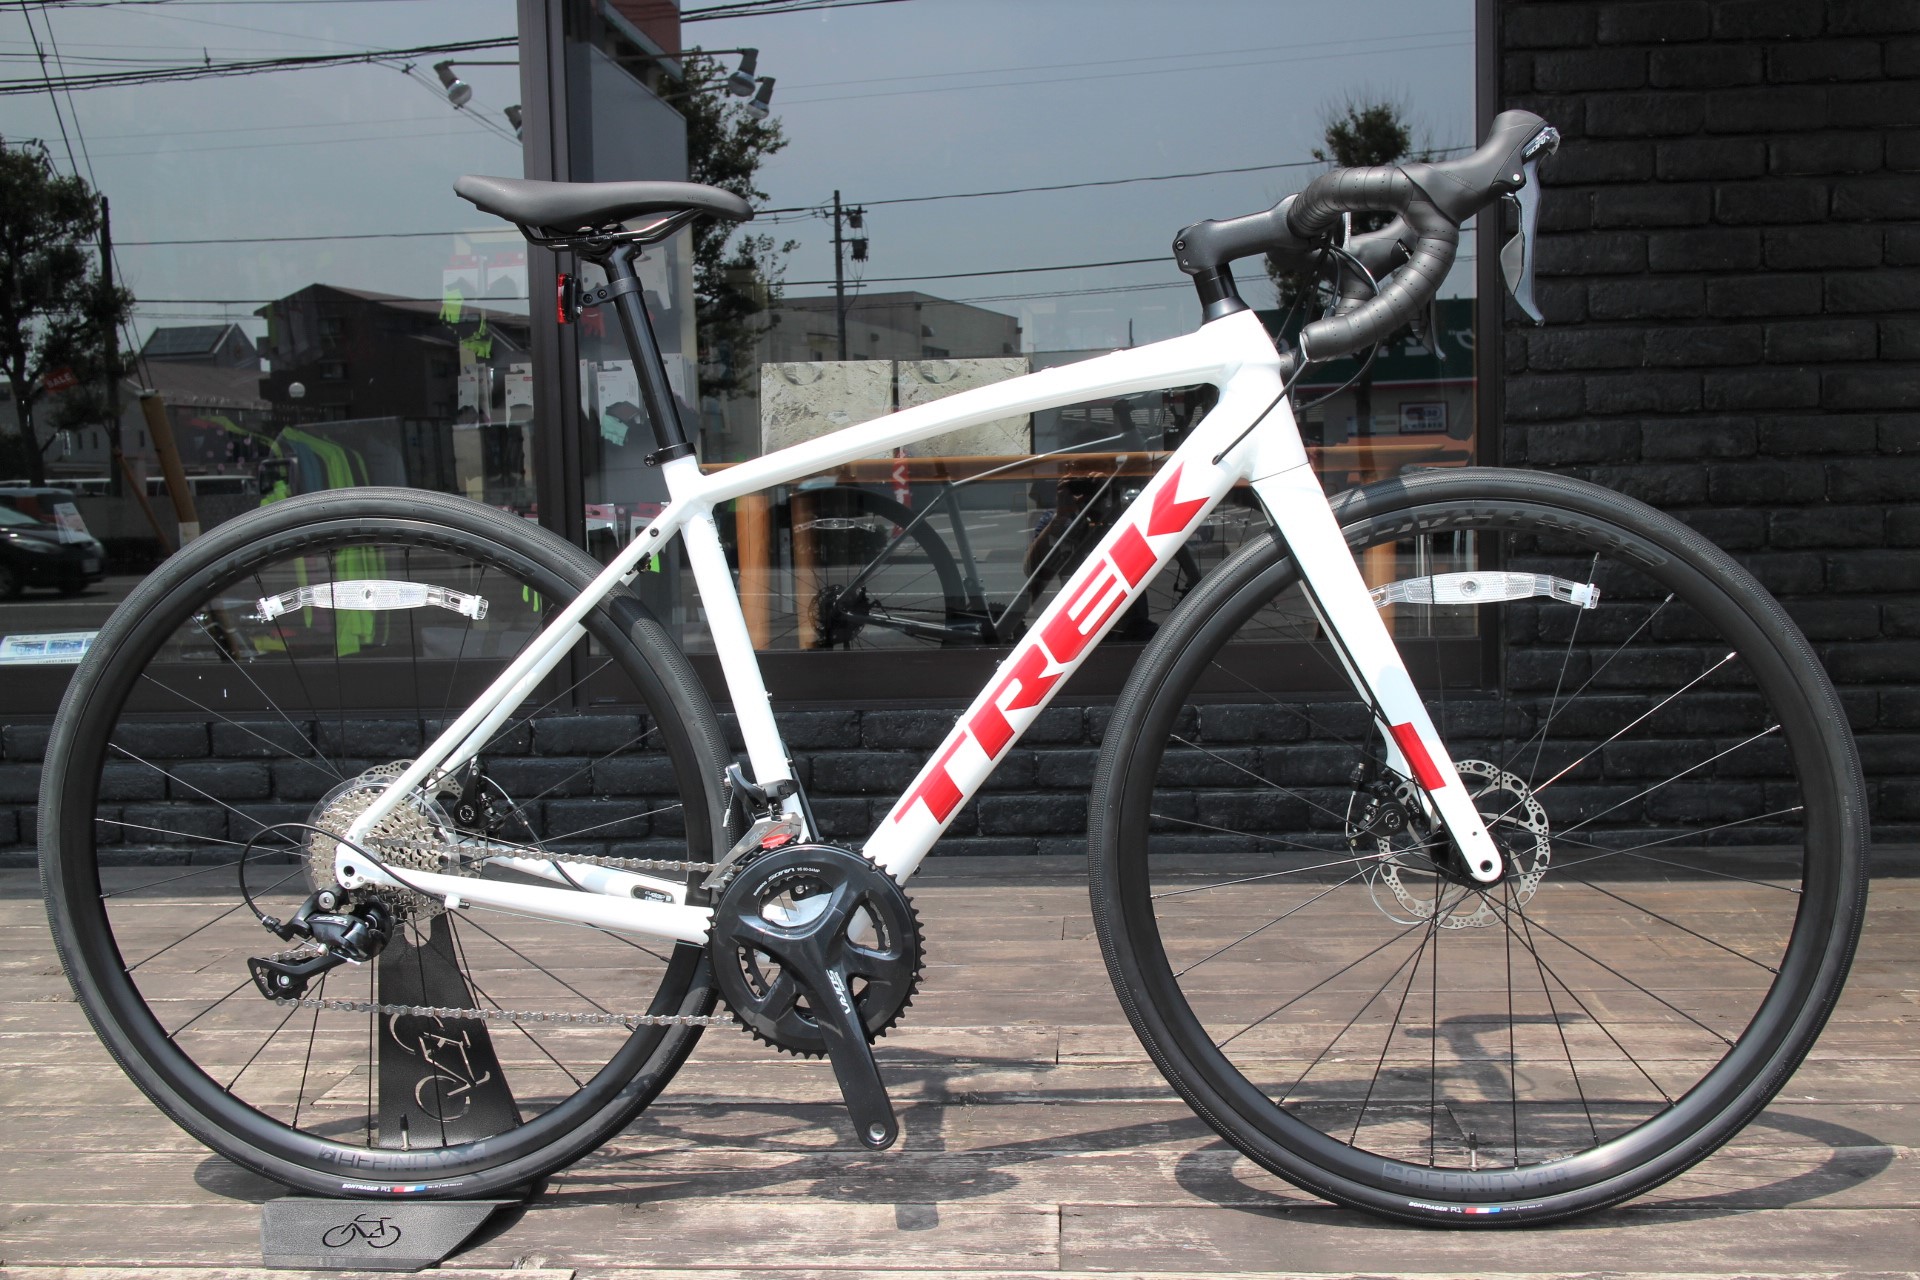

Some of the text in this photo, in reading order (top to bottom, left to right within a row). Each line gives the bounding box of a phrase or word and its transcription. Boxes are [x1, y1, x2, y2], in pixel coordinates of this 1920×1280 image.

[893, 461, 1211, 825] TREK
[767, 867, 795, 882] SORA
[825, 969, 851, 1015] SORA
[342, 1183, 379, 1191] BONTRAGER
[1408, 1201, 1448, 1212] BONTRAGER
